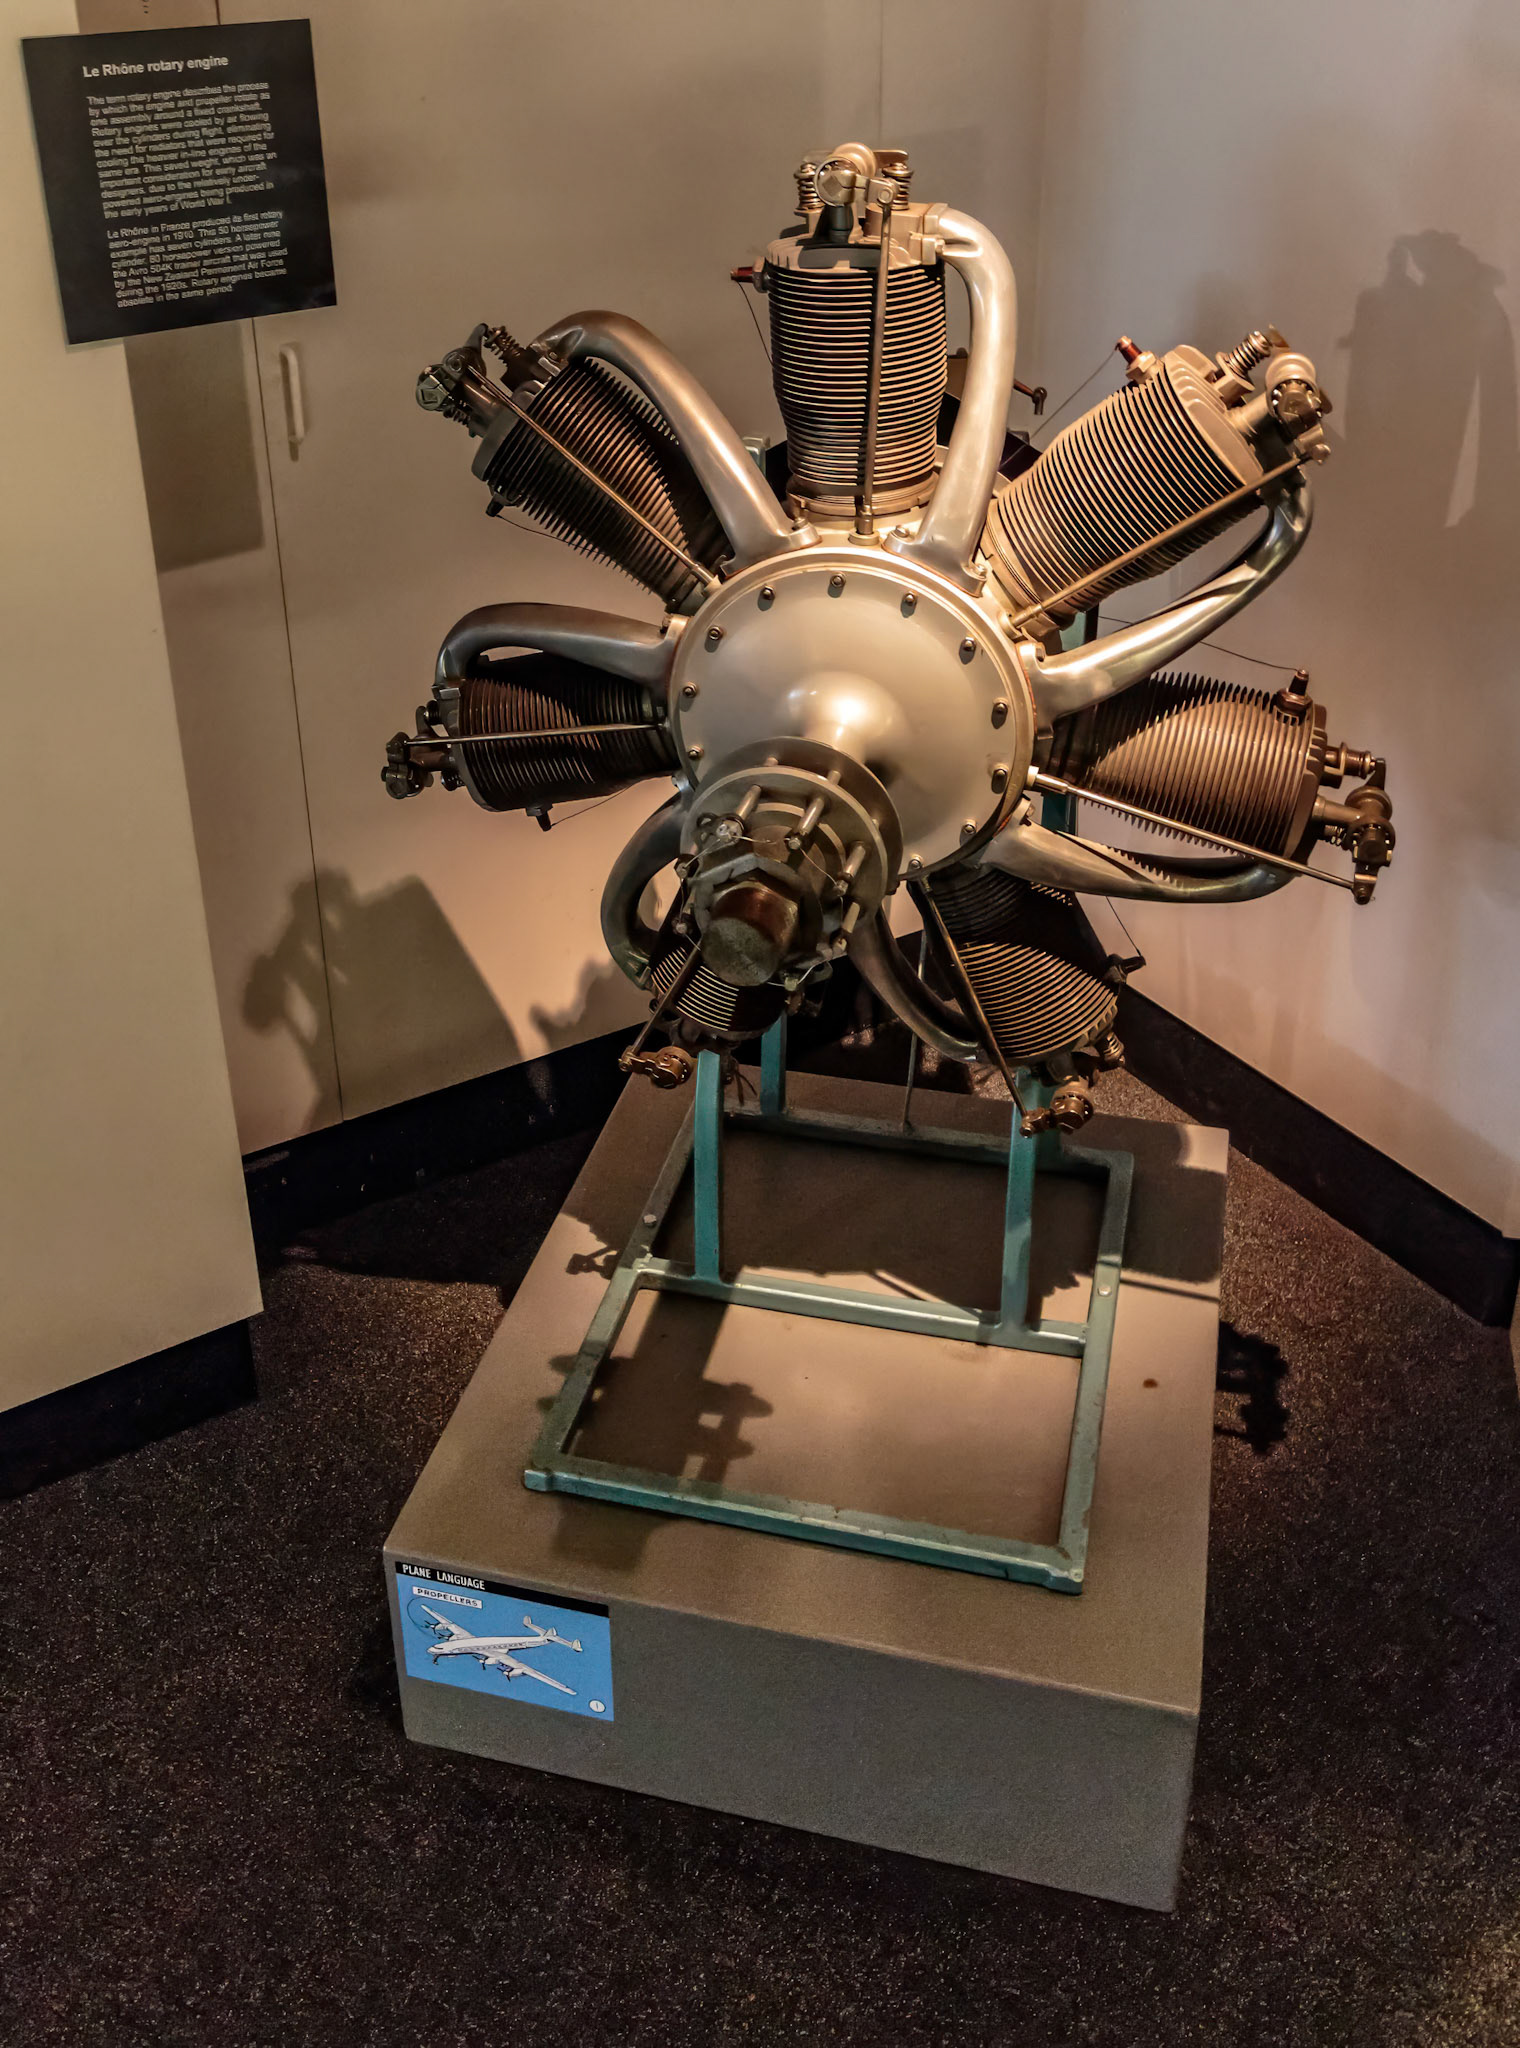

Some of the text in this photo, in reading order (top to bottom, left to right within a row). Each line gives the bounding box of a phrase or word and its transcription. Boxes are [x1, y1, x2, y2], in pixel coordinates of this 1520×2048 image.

[82, 56, 229, 78] Le Rhône rotary engine
[402, 1564, 486, 1590] PLANE LANGUAGE
[417, 1588, 478, 1607] PROPELLERS
